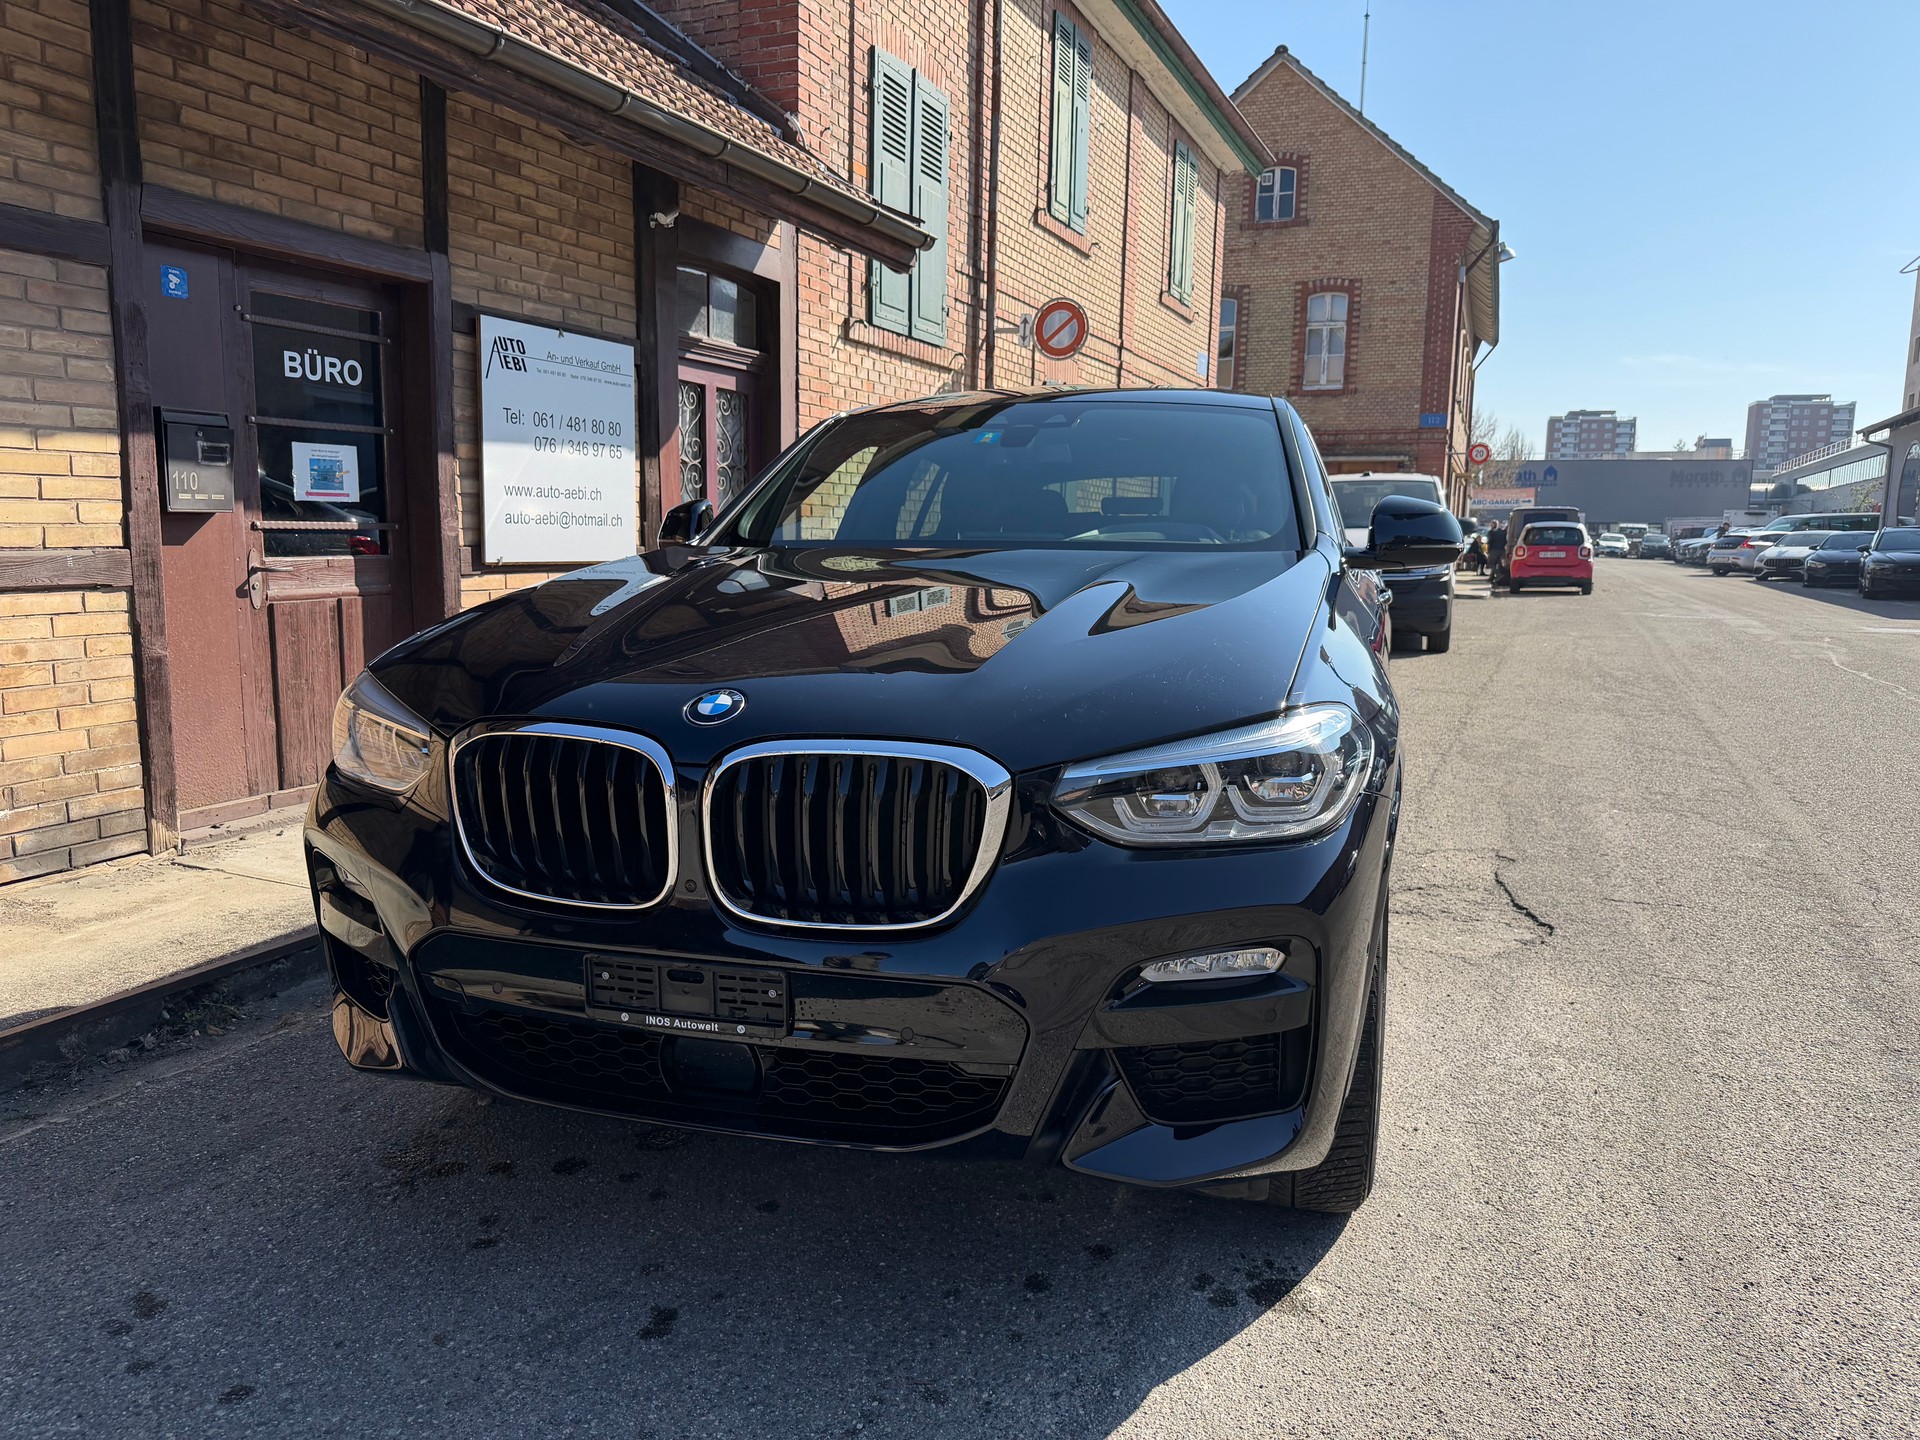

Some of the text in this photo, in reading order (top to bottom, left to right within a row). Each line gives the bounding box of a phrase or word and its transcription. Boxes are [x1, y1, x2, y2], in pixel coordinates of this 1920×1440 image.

[283, 348, 363, 386] BÜRO
[546, 351, 621, 373] An- und Verkauf GmbH
[503, 407, 621, 437] Tel: 061 / 481 80 80
[534, 436, 622, 459] 076 / 346 97 65
[1474, 449, 1484, 458] 20
[172, 470, 198, 490] 110
[1670, 469, 1724, 482] Morath
[503, 485, 602, 501] www.auto-aebi.ch
[504, 511, 623, 529] auto-aebi@hotmail.ch
[645, 1015, 719, 1032] INOS Autowelt
